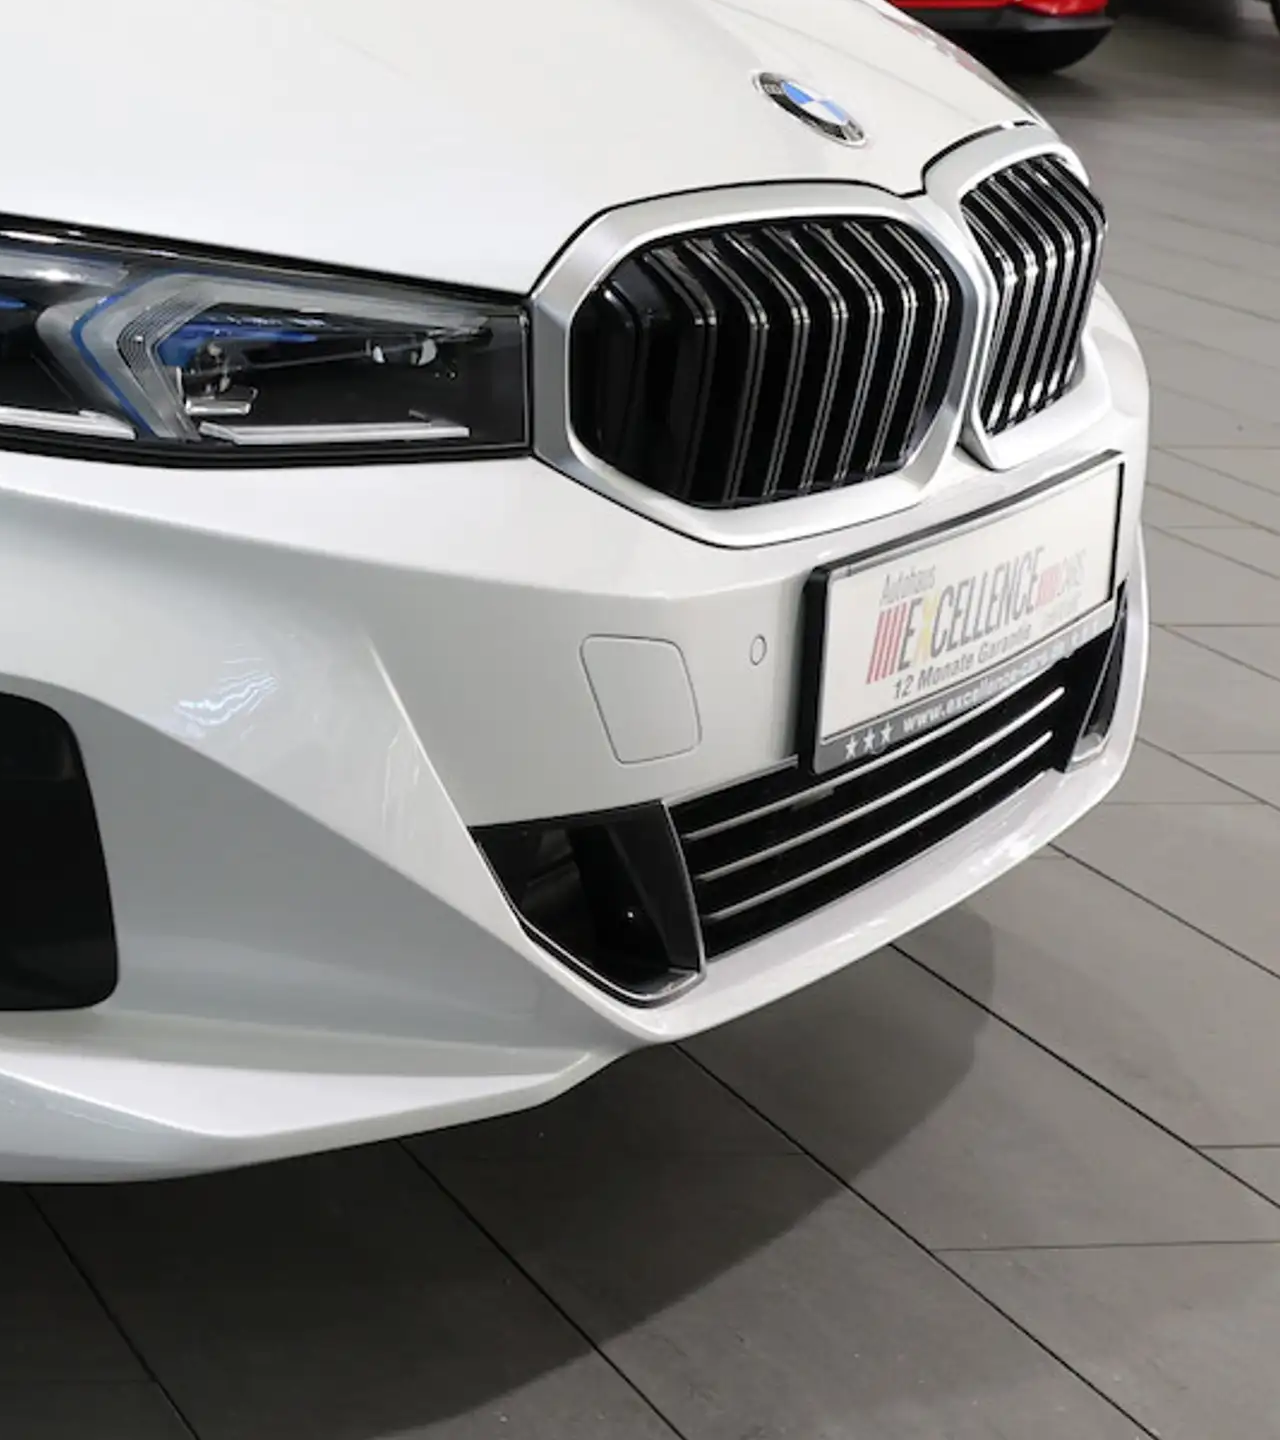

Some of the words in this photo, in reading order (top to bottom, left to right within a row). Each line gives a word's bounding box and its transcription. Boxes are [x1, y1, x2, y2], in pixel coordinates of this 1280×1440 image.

[897, 546, 1045, 672] EXCELLENCE
[894, 677, 912, 699] 12
[917, 651, 976, 691] Monate
